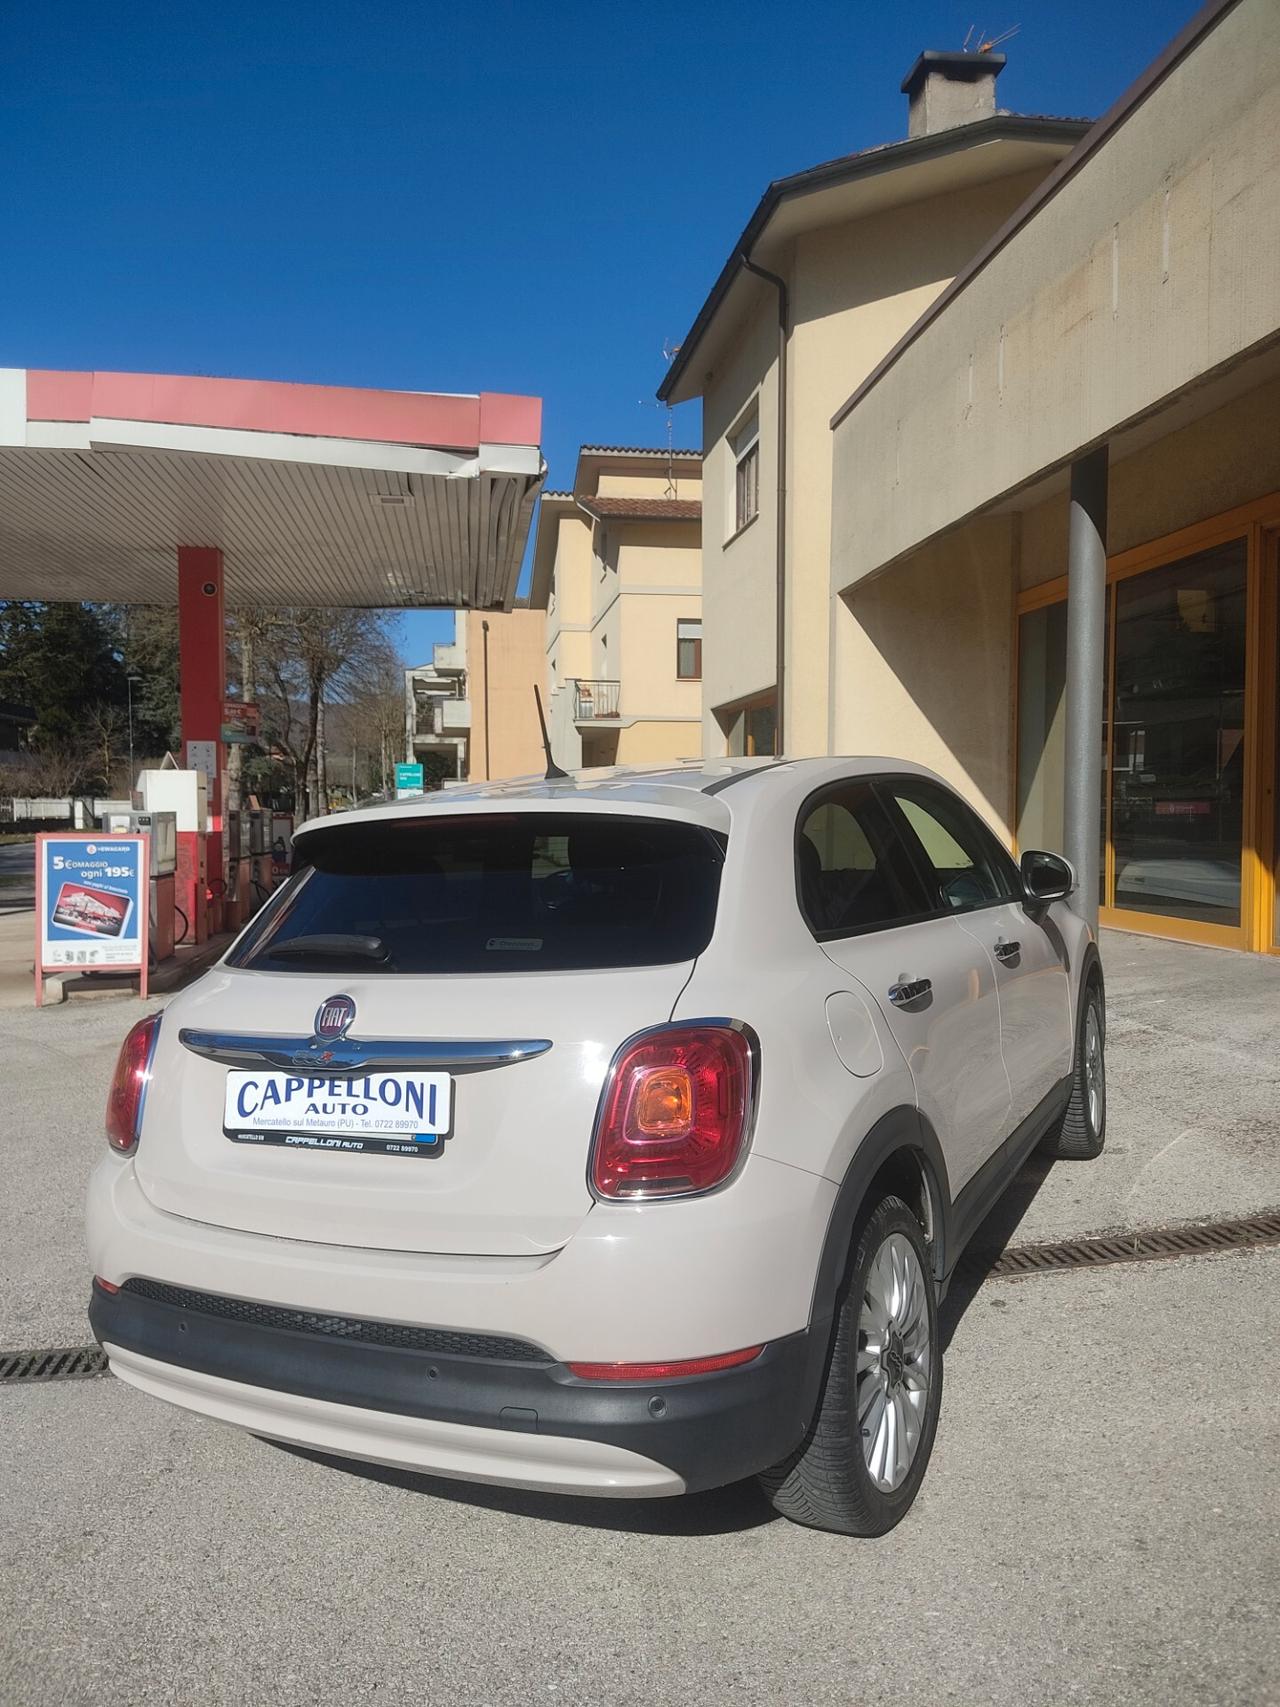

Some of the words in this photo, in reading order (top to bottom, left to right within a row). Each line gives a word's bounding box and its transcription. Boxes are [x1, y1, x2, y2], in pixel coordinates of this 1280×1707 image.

[80, 869, 102, 880] ogni
[105, 866, 135, 878] 195€
[321, 1007, 347, 1027] FIAT
[237, 1076, 437, 1127] CAPPELLONI
[304, 1103, 369, 1116] AUTO
[252, 1117, 292, 1126] Mercatello
[292, 1118, 305, 1127] sul
[306, 1118, 336, 1127] Metauro
[337, 1119, 354, 1129] (PU)
[360, 1119, 372, 1128] Tel.
[374, 1120, 395, 1129] 0722
[395, 1120, 419, 1129] 89970
[285, 1136, 342, 1148] CAPPELLONI
[342, 1141, 364, 1149] AUTO
[386, 1144, 400, 1152] 0722
[400, 1145, 419, 1153] 89970
